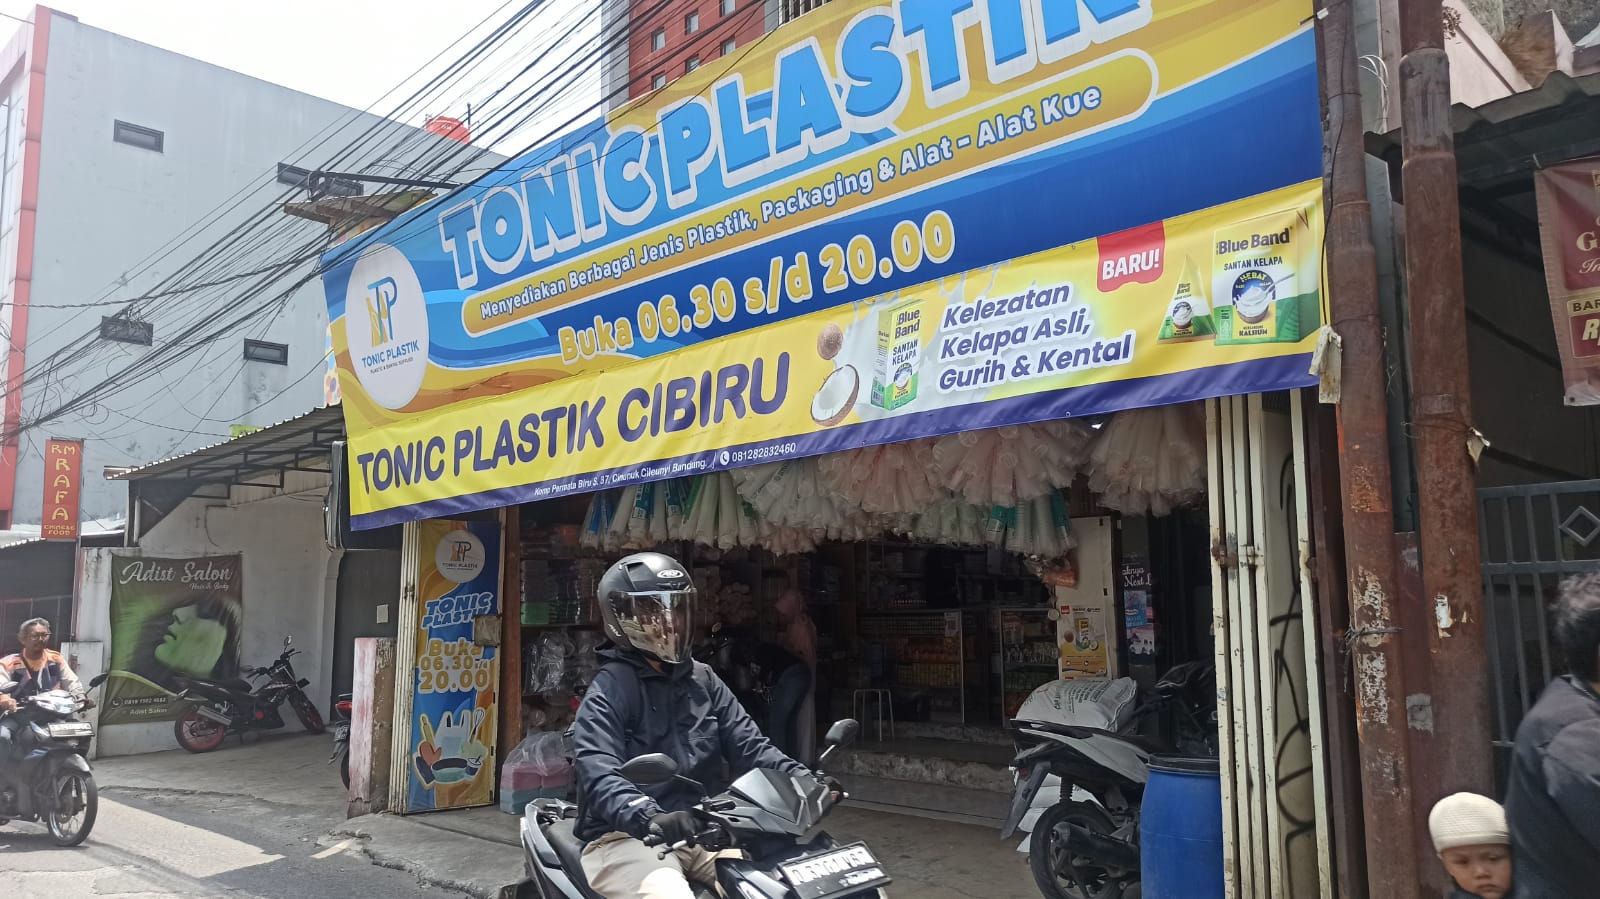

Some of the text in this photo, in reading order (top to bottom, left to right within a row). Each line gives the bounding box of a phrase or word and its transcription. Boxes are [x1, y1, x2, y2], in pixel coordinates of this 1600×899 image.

[438, 124, 658, 290] TONIC
[480, 277, 567, 320] Menyediakan
[568, 249, 636, 290] Berbagai
[639, 234, 684, 266] Jenis
[686, 208, 758, 250] Plastik,
[761, 167, 874, 224] Packaging
[877, 158, 896, 182] &
[899, 136, 953, 174] Alat
[976, 105, 1037, 148] Alat
[1041, 86, 1102, 126] Kue
[1219, 228, 1290, 255] Blue Band
[1102, 248, 1160, 281] BARU!
[1224, 256, 1283, 271] SANTAN KELAPA
[558, 209, 955, 365] Buka 06.30 s/d 20.00
[897, 309, 920, 326] Blue
[943, 284, 1070, 329] Kelezatan
[894, 319, 920, 340] Band
[940, 308, 1090, 360] Kelapa Asli,
[362, 339, 420, 368] TONIC PLASTIK
[892, 350, 917, 366] KELAPA
[893, 339, 918, 356] SANTAN
[939, 334, 1132, 390] Gurih & Kental
[356, 351, 790, 495] TONIC PLASTIK CIBIRU
[51, 444, 76, 456] RM
[551, 482, 577, 495] Permata
[578, 479, 592, 489] Biru
[640, 465, 671, 481] Cileunyi
[731, 442, 796, 463] 081282832460
[52, 457, 71, 521] RAFA
[119, 561, 232, 584] Adist Salon
[425, 592, 493, 616] TONIC
[428, 637, 485, 657] Buka
[420, 656, 473, 671] 06.30
[419, 670, 490, 693] 20.00
